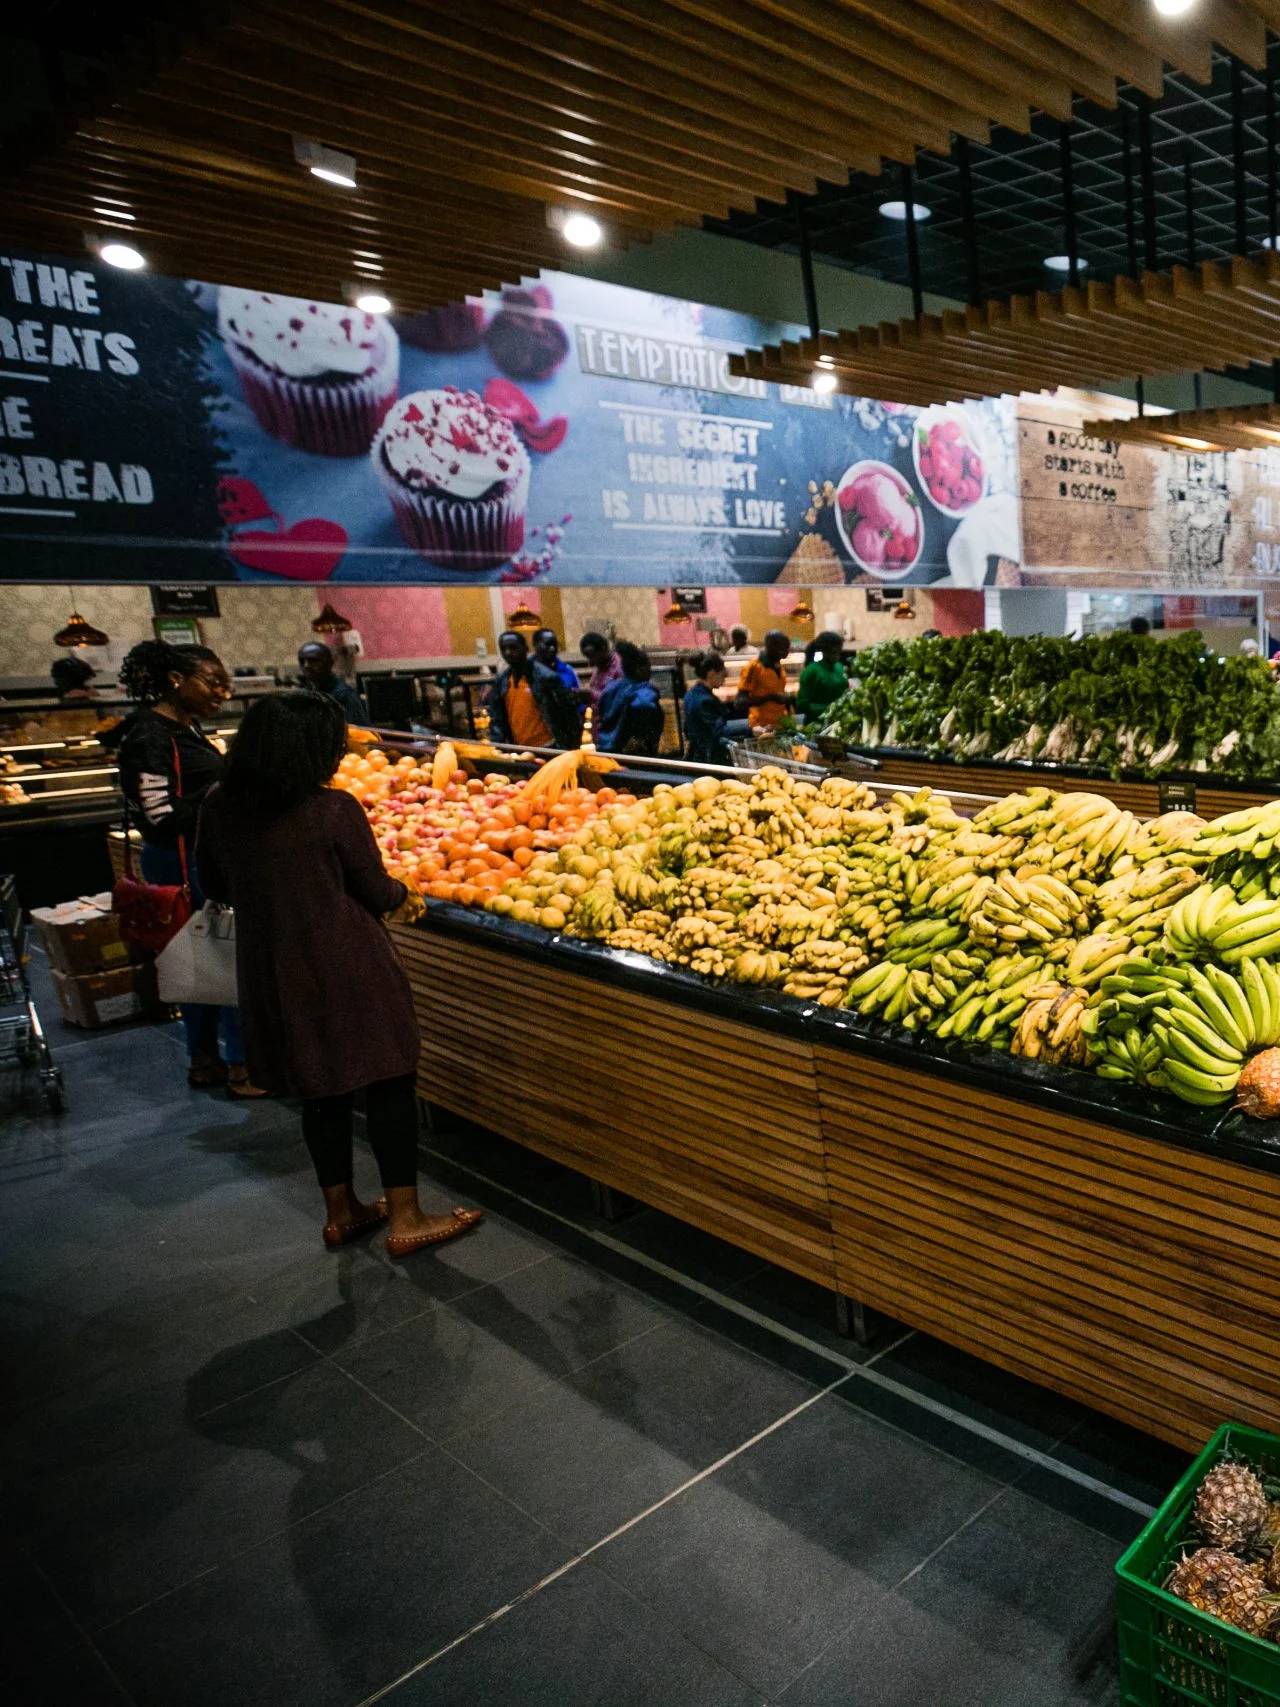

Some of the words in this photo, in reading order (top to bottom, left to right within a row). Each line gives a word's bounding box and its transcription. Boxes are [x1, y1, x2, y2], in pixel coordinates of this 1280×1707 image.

[1, 257, 101, 315] THE
[0, 396, 34, 439] E
[619, 413, 666, 445] THE
[677, 417, 759, 456] SECRET
[0, 453, 154, 504] BREAD
[628, 452, 758, 491] INGREDIENT
[1071, 482, 1117, 502] coffee
[602, 489, 631, 519] IS
[643, 493, 729, 526] ALWAYS
[735, 498, 787, 529] LOVE
